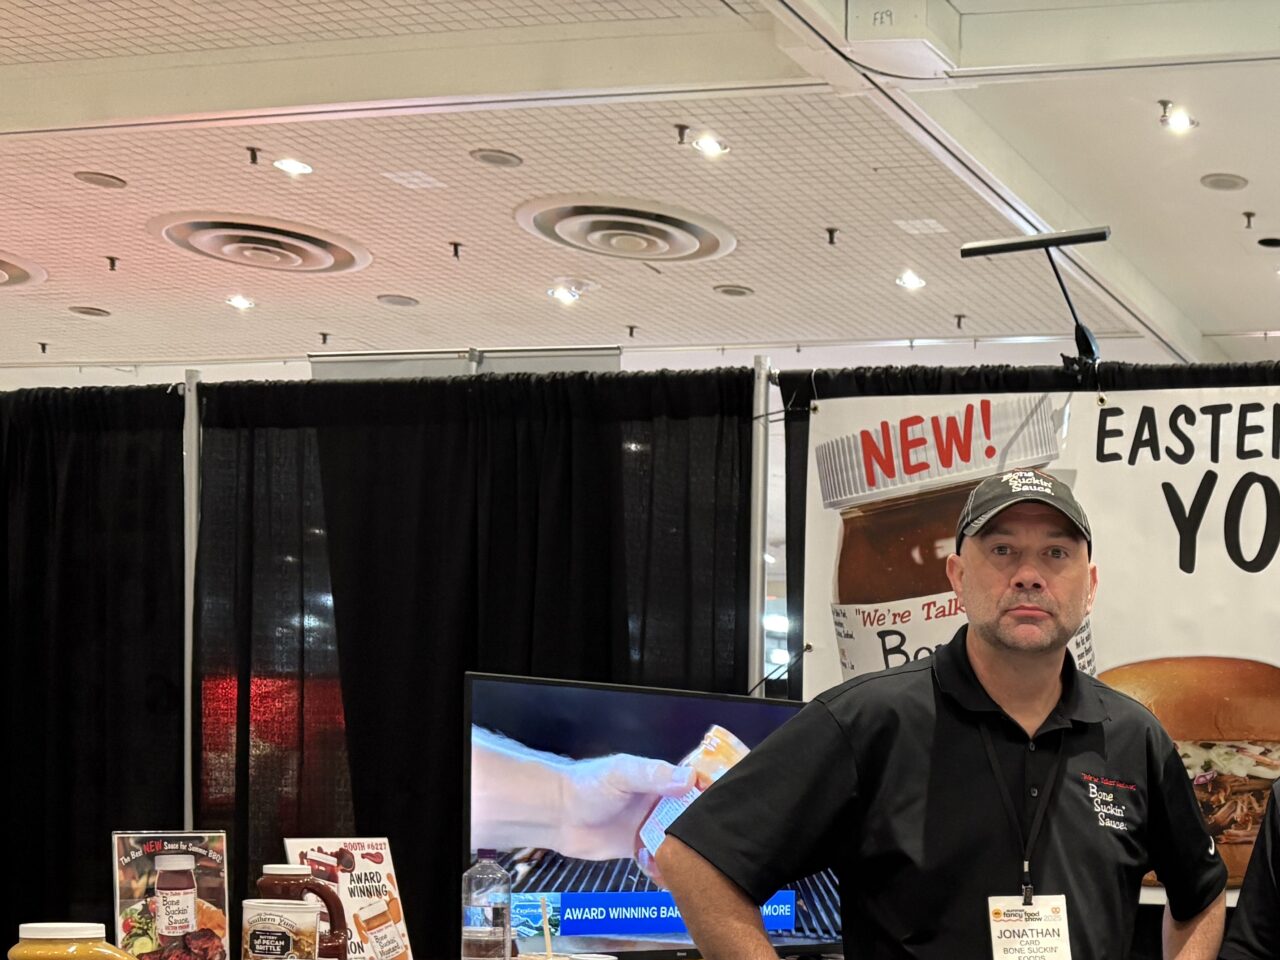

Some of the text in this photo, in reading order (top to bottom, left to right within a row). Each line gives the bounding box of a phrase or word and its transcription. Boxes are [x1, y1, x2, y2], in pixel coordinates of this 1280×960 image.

[860, 399, 997, 487] NEW!
[855, 608, 911, 628] "We're
[1088, 783, 1113, 801] Bone
[1094, 798, 1126, 817] Suckin'
[143, 840, 163, 854] NEW
[349, 871, 382, 885] AWARD
[347, 884, 388, 898] WINNING
[162, 895, 180, 906] Bone
[564, 903, 791, 920] AWARD WINNING MORE
[997, 928, 1061, 939] JONATHAN
